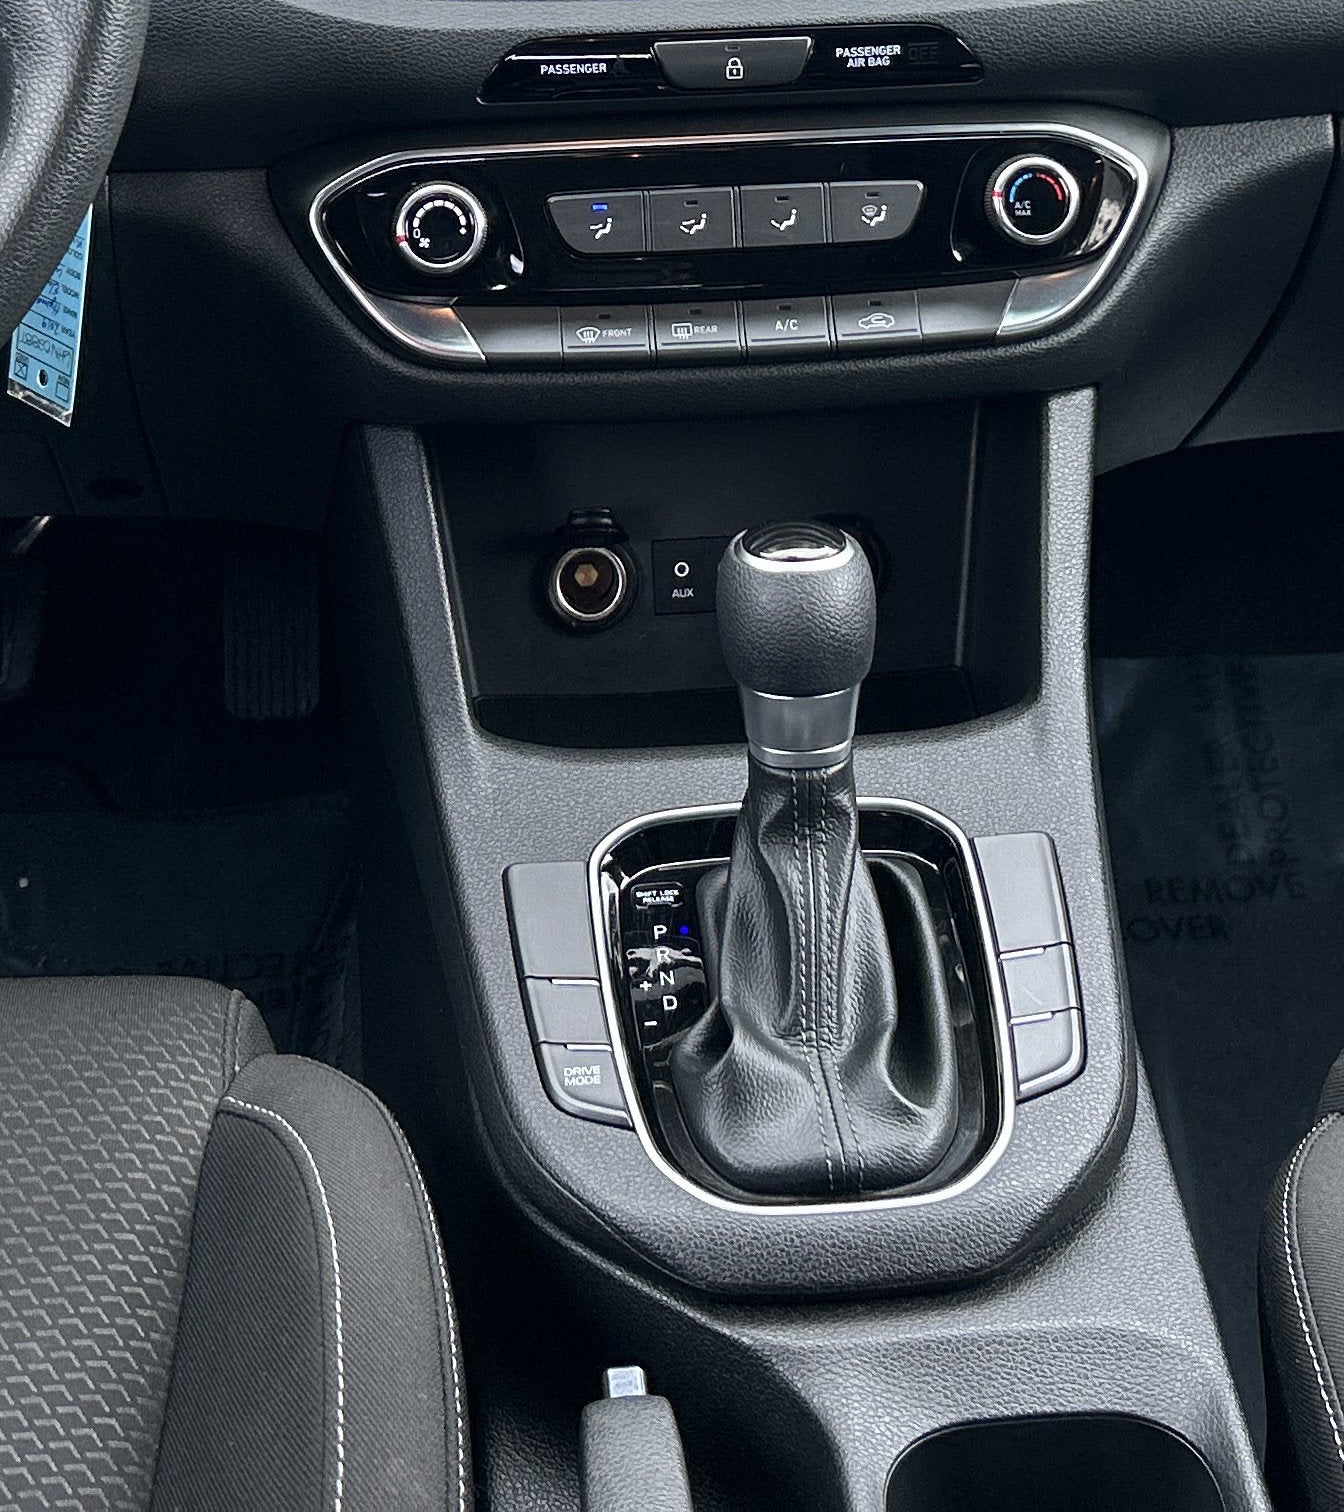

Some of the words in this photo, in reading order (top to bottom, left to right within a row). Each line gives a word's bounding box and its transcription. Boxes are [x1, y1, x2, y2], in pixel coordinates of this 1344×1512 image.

[835, 45, 902, 58] PASSENGER
[847, 55, 867, 68] AIR
[868, 54, 891, 67] BAG
[540, 63, 607, 76] PASSENGER
[1014, 199, 1032, 210] A/C
[693, 325, 719, 335] REAR
[775, 318, 799, 332] A/C
[602, 327, 633, 338] FRONT
[671, 587, 695, 598] AUX
[1143, 869, 1308, 906] REMOVE
[654, 924, 668, 940] P
[656, 947, 671, 963] R
[659, 970, 676, 986] N
[662, 995, 678, 1011] D
[563, 1064, 601, 1077] DRIVE
[564, 1073, 602, 1087] MODE
